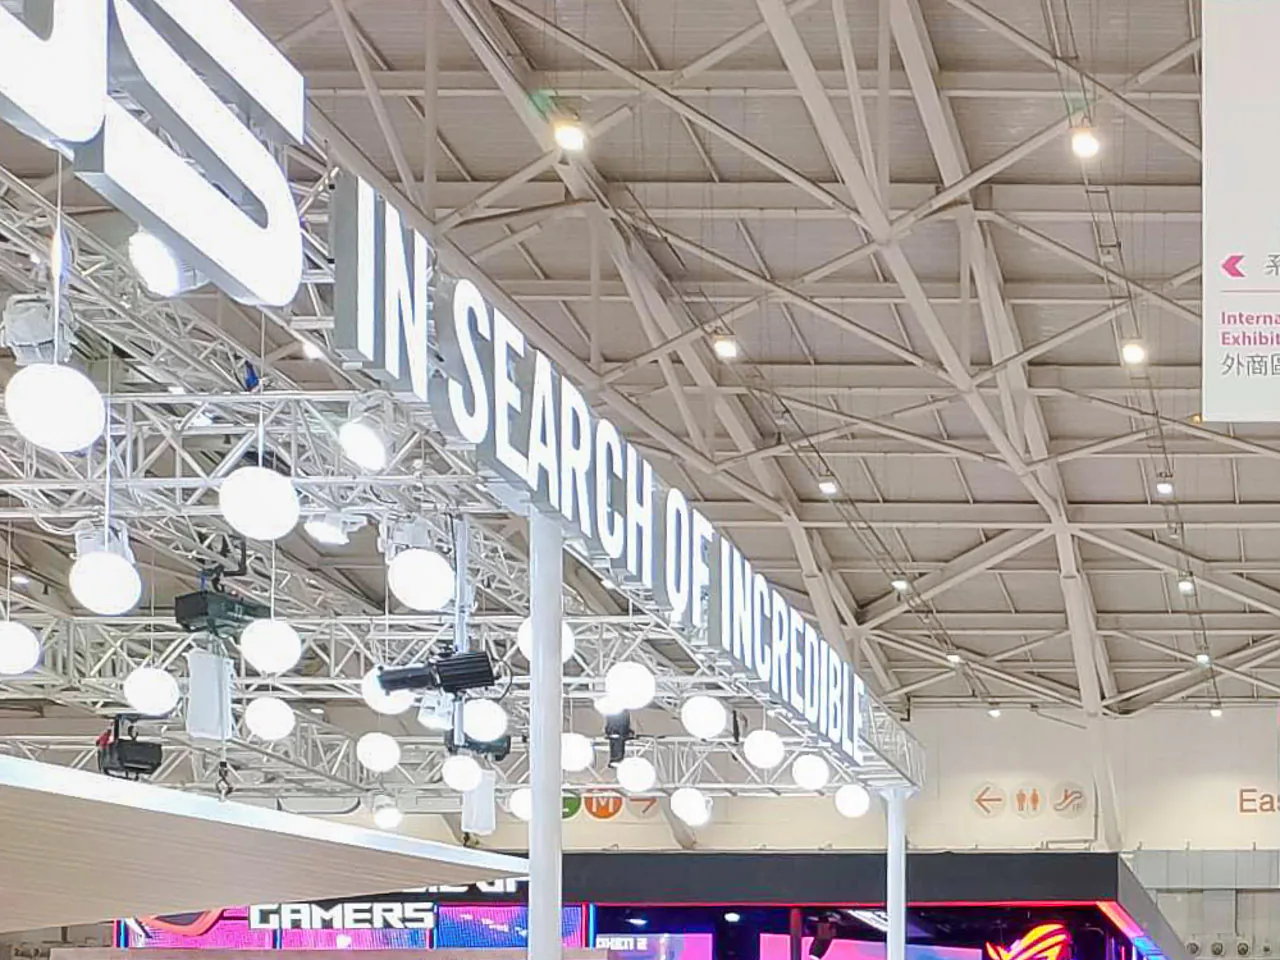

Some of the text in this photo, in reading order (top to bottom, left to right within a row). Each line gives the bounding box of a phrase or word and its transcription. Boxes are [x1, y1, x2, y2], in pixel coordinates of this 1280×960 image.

[356, 176, 865, 766] IN SEARCH OF INCREDIBLE
[248, 902, 437, 929] GAMERS
